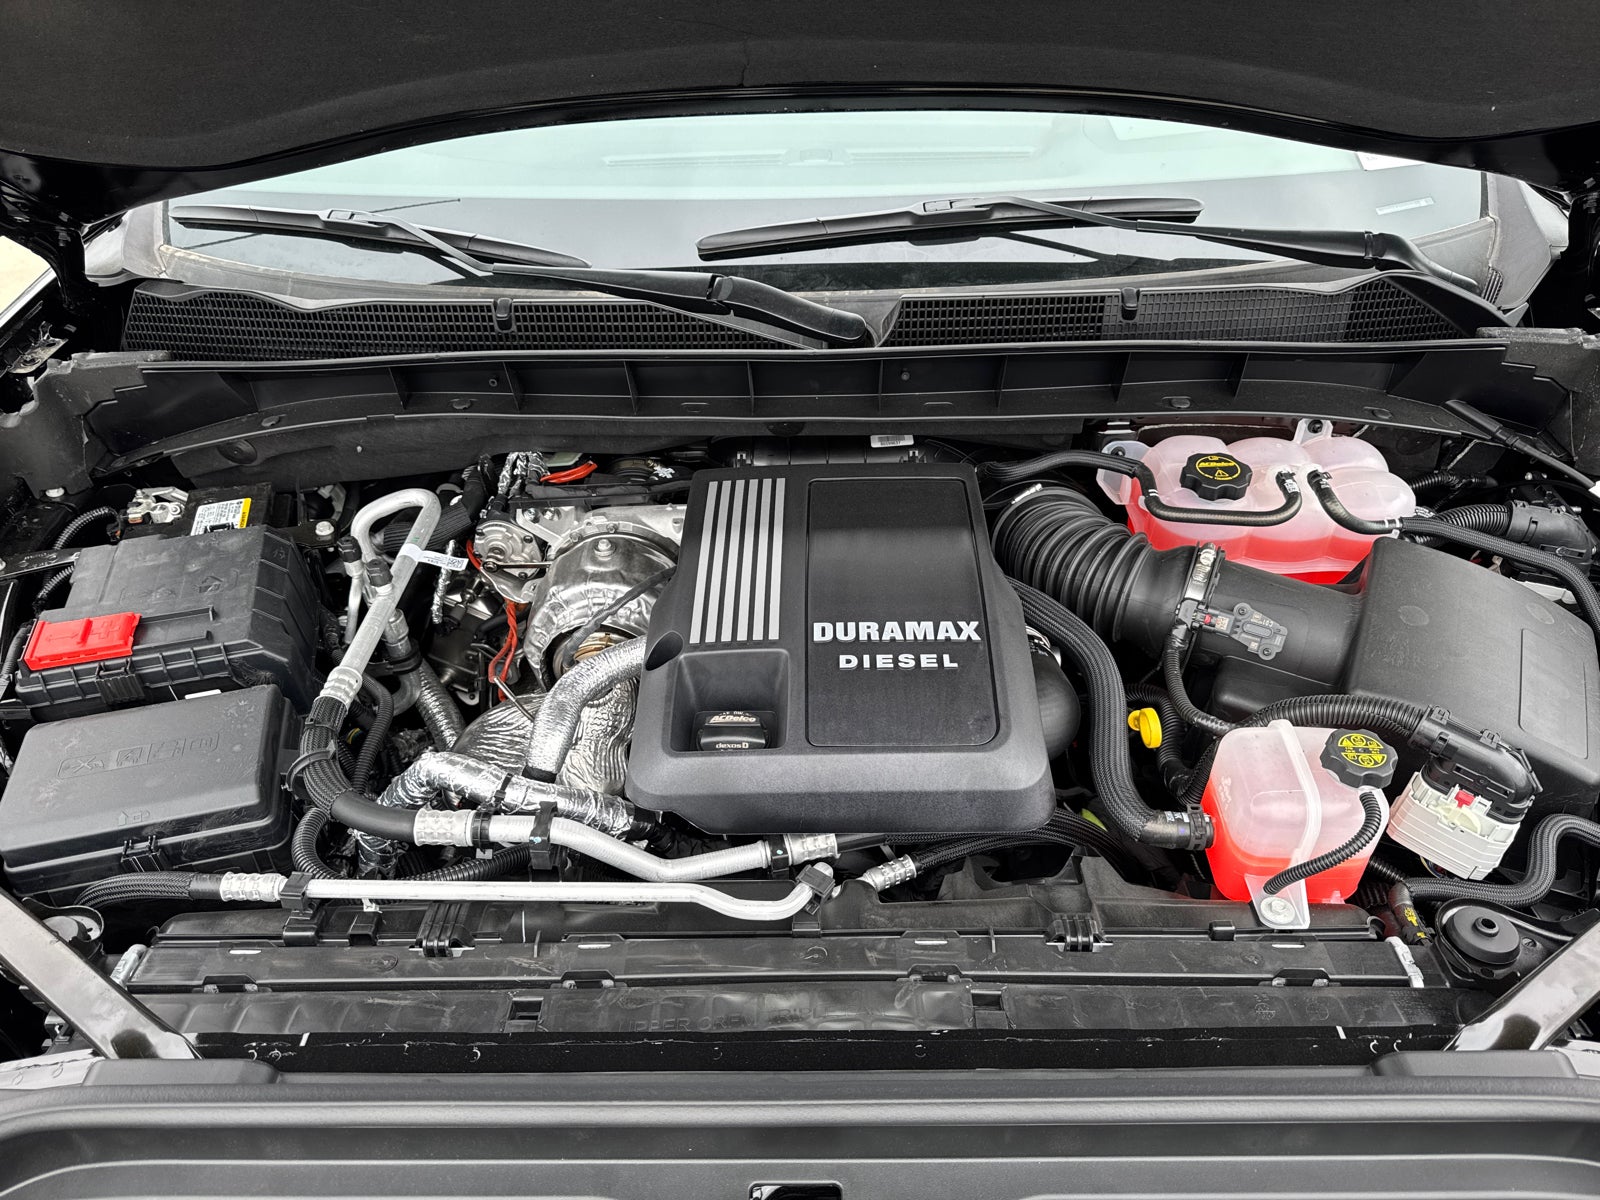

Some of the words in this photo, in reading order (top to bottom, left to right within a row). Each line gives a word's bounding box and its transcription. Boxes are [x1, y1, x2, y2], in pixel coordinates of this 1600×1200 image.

[813, 621, 982, 642] DURAMAX
[839, 653, 959, 669] DIESEL
[709, 715, 757, 723] ACDelco
